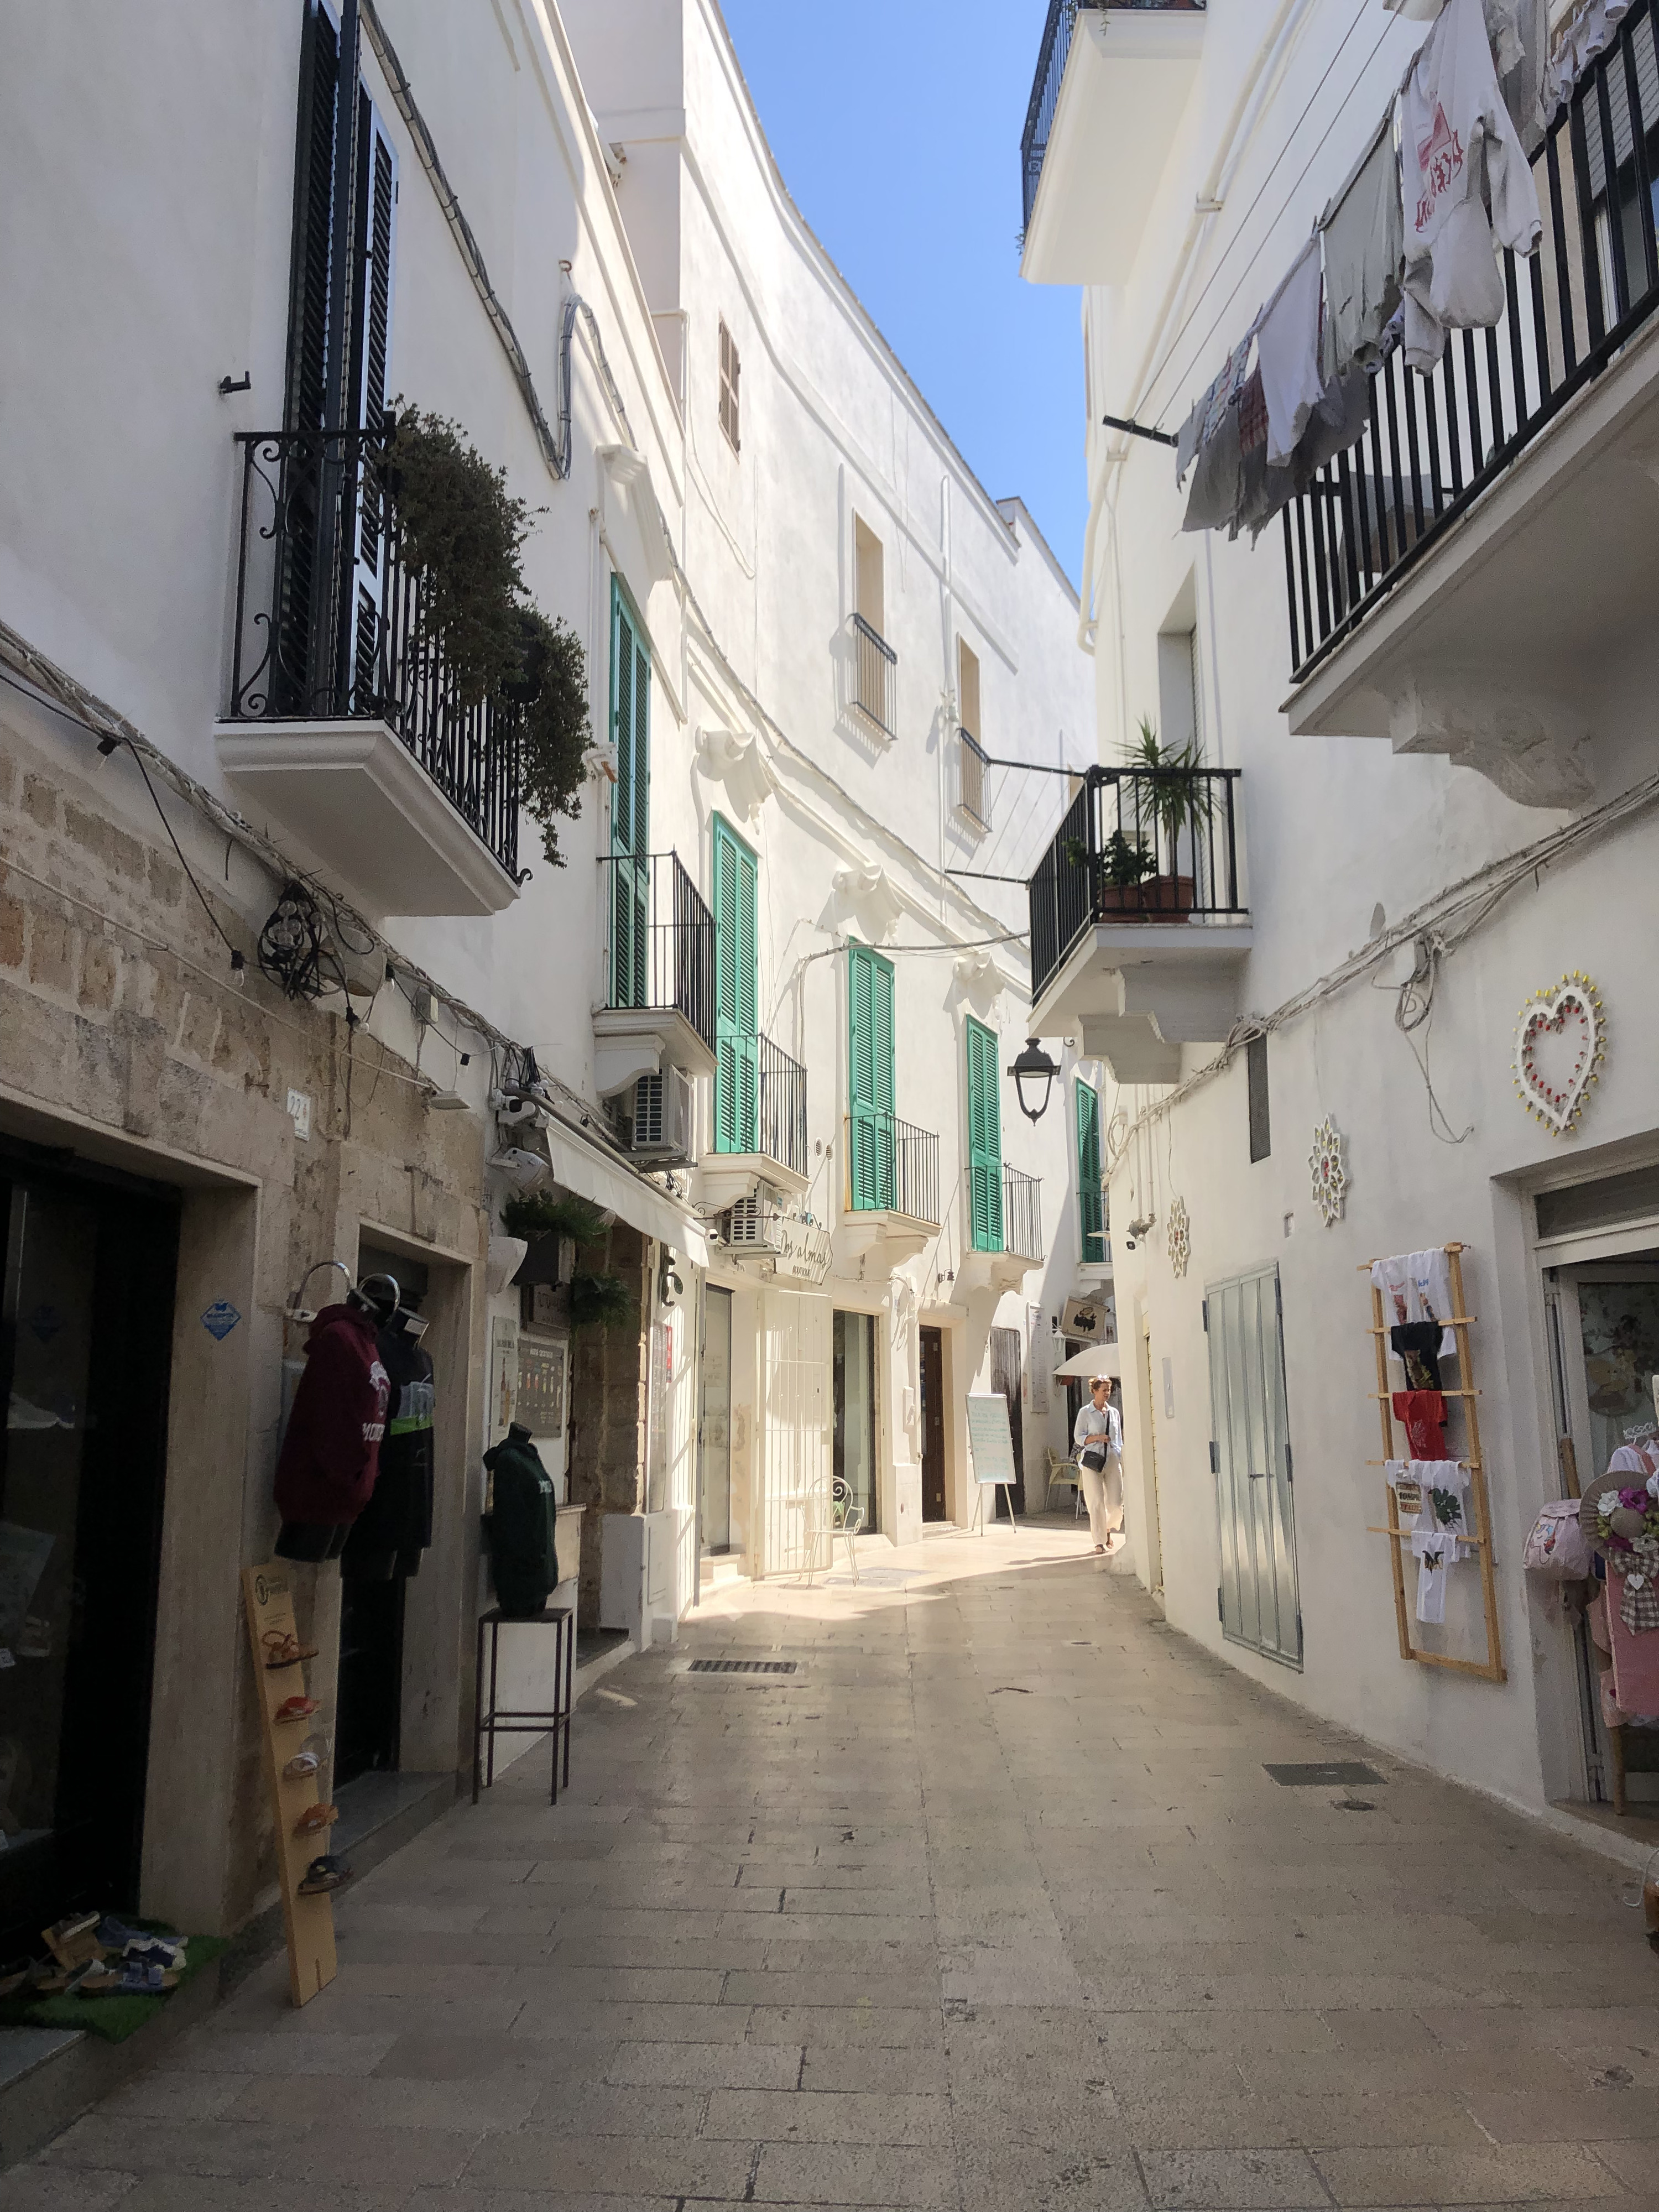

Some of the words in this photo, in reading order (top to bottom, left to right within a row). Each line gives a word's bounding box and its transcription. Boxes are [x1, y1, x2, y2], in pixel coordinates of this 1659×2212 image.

[781, 1229, 797, 1260] Dos
[797, 1232, 830, 1269] almas
[792, 1265, 811, 1276] BOUTIQUE
